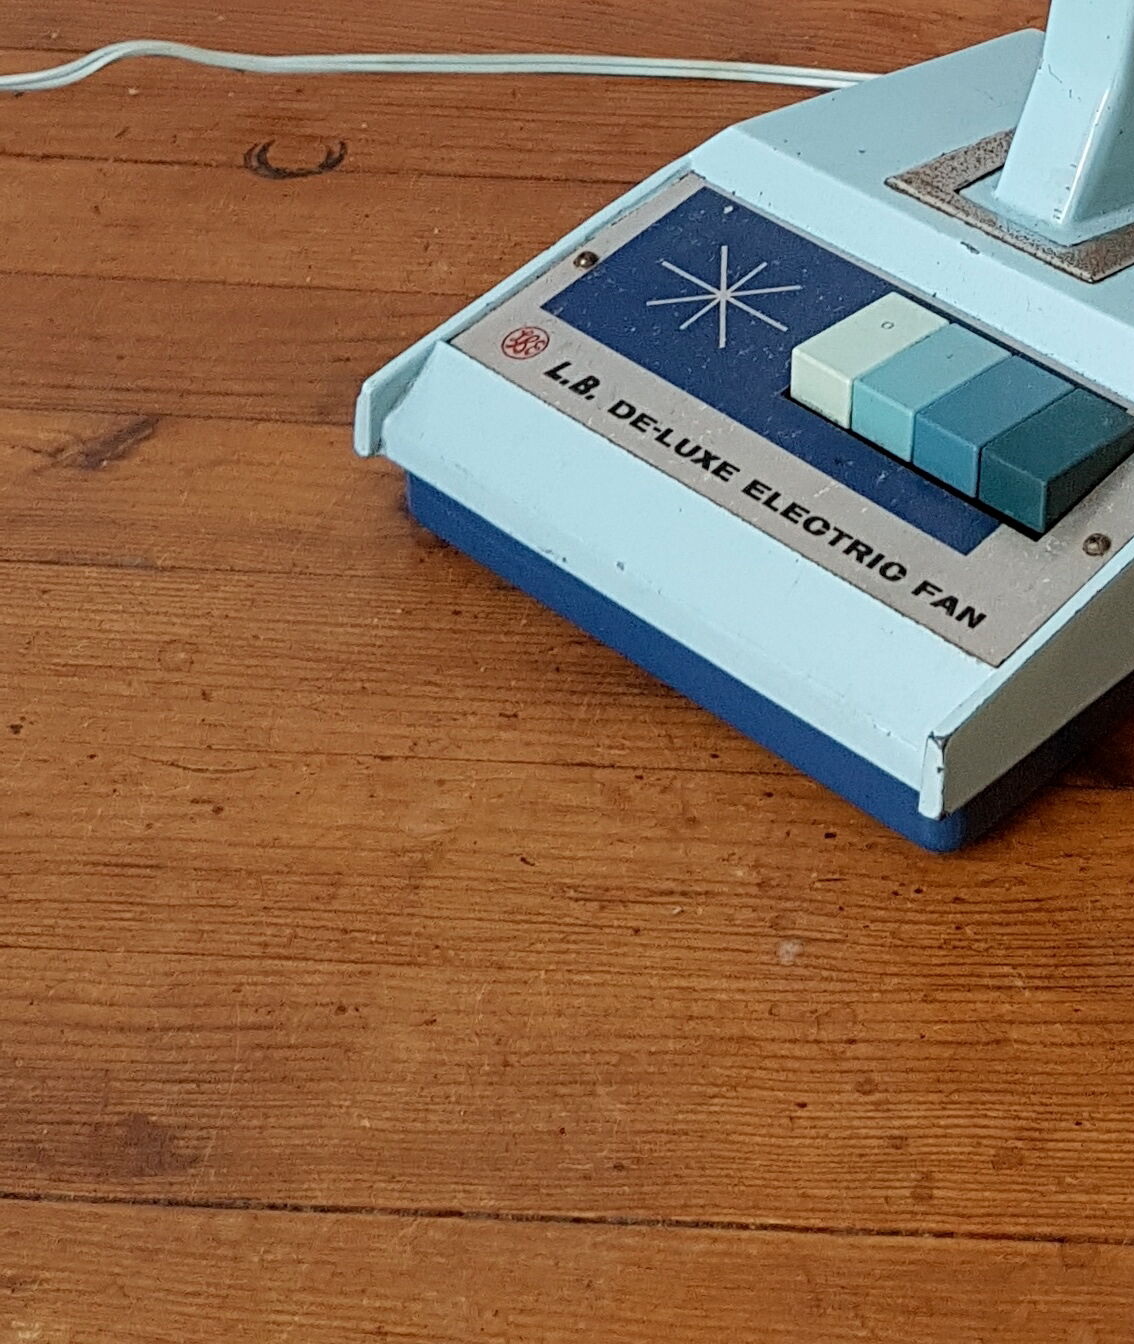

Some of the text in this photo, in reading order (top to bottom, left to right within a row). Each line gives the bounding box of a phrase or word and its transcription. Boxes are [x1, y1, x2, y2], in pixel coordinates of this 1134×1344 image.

[543, 360, 988, 630] L.B. DE-LUXE ELECTRIC FAN
